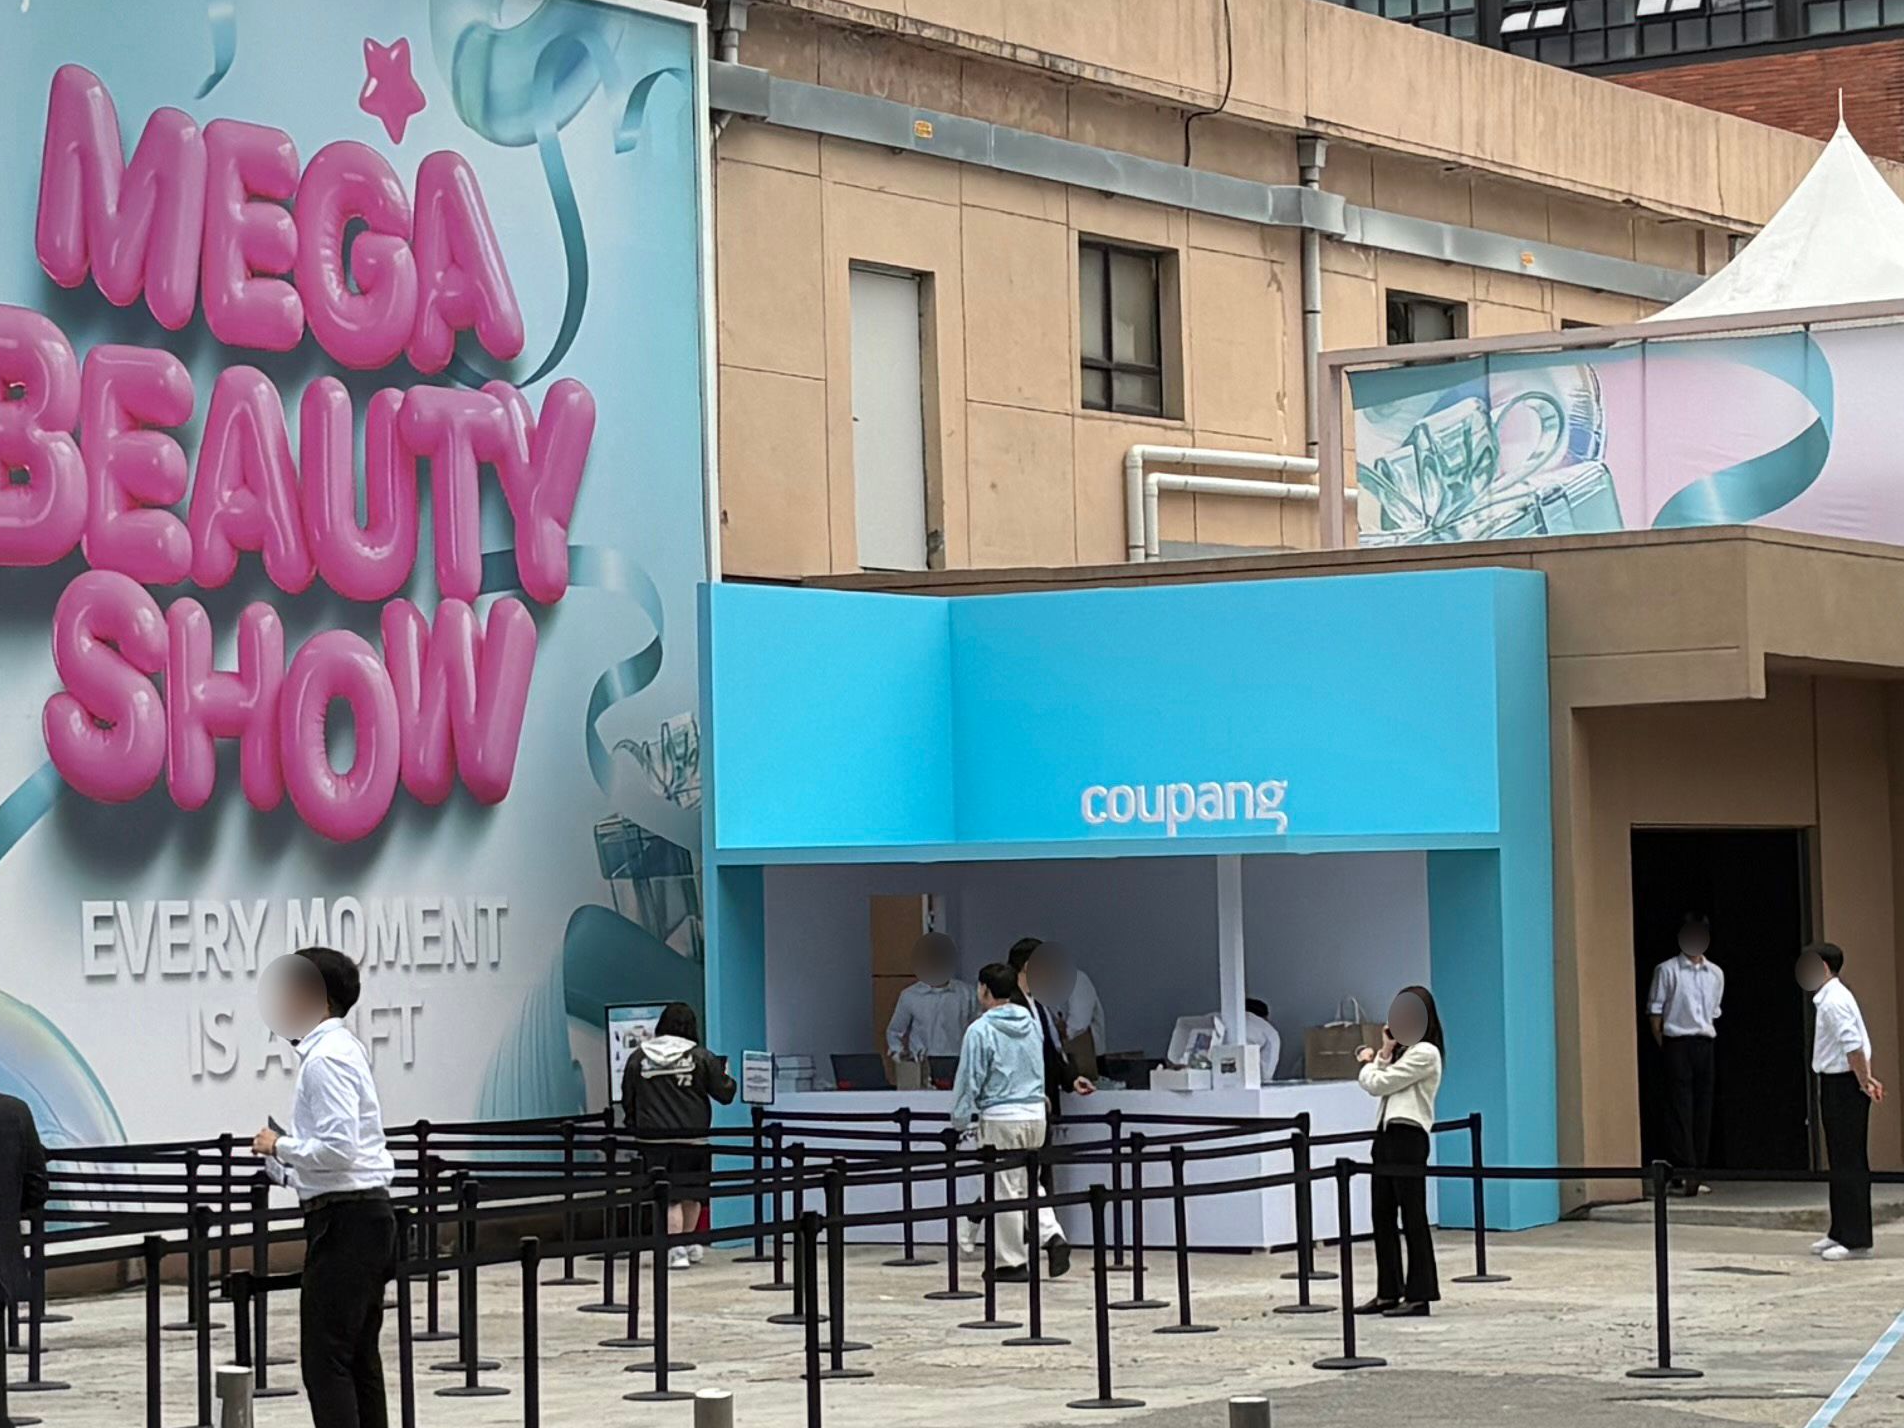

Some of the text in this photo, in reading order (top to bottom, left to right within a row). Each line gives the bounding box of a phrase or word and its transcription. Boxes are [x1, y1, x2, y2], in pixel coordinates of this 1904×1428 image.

[35, 63, 525, 373] MEGA
[43, 570, 538, 843] SHOW
[1081, 780, 1288, 837] coupang
[81, 896, 510, 977] EVERY MOMENT
[190, 1008, 239, 1079] IS
